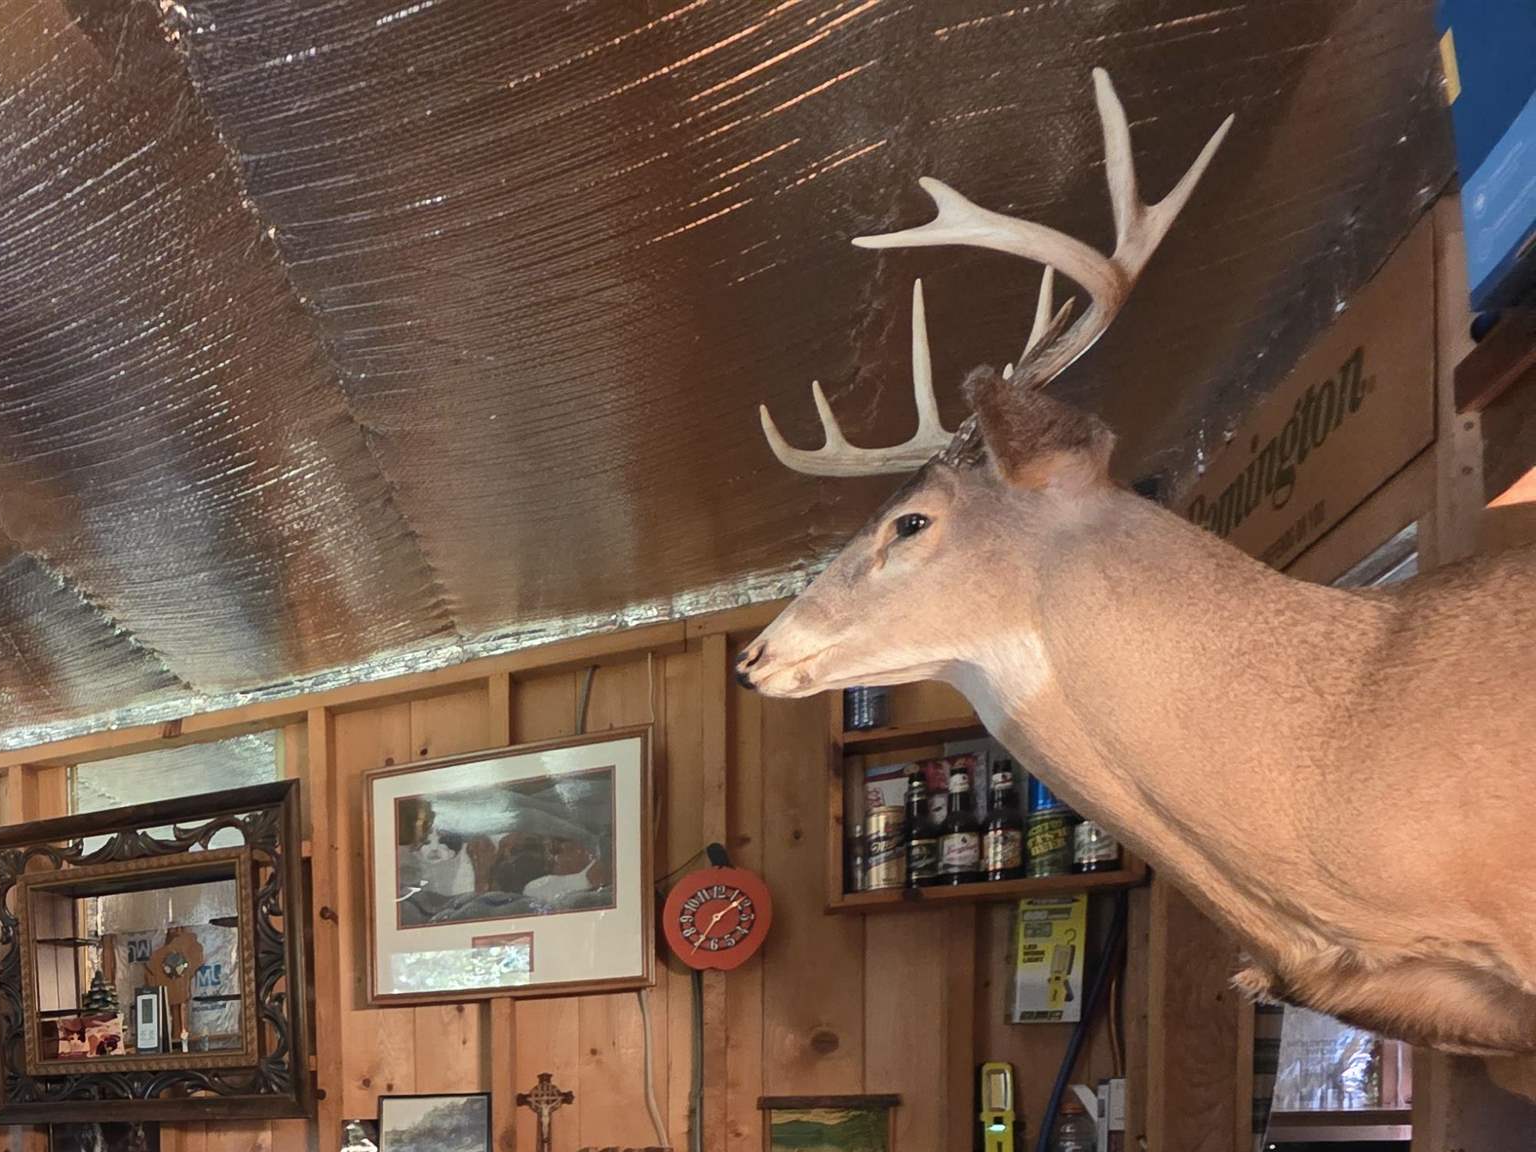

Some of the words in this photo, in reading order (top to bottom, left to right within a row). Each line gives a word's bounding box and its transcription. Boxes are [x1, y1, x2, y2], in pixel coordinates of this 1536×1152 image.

[1189, 346, 1364, 540] emington
[713, 886, 725, 898] 12
[710, 939, 718, 950] 6
